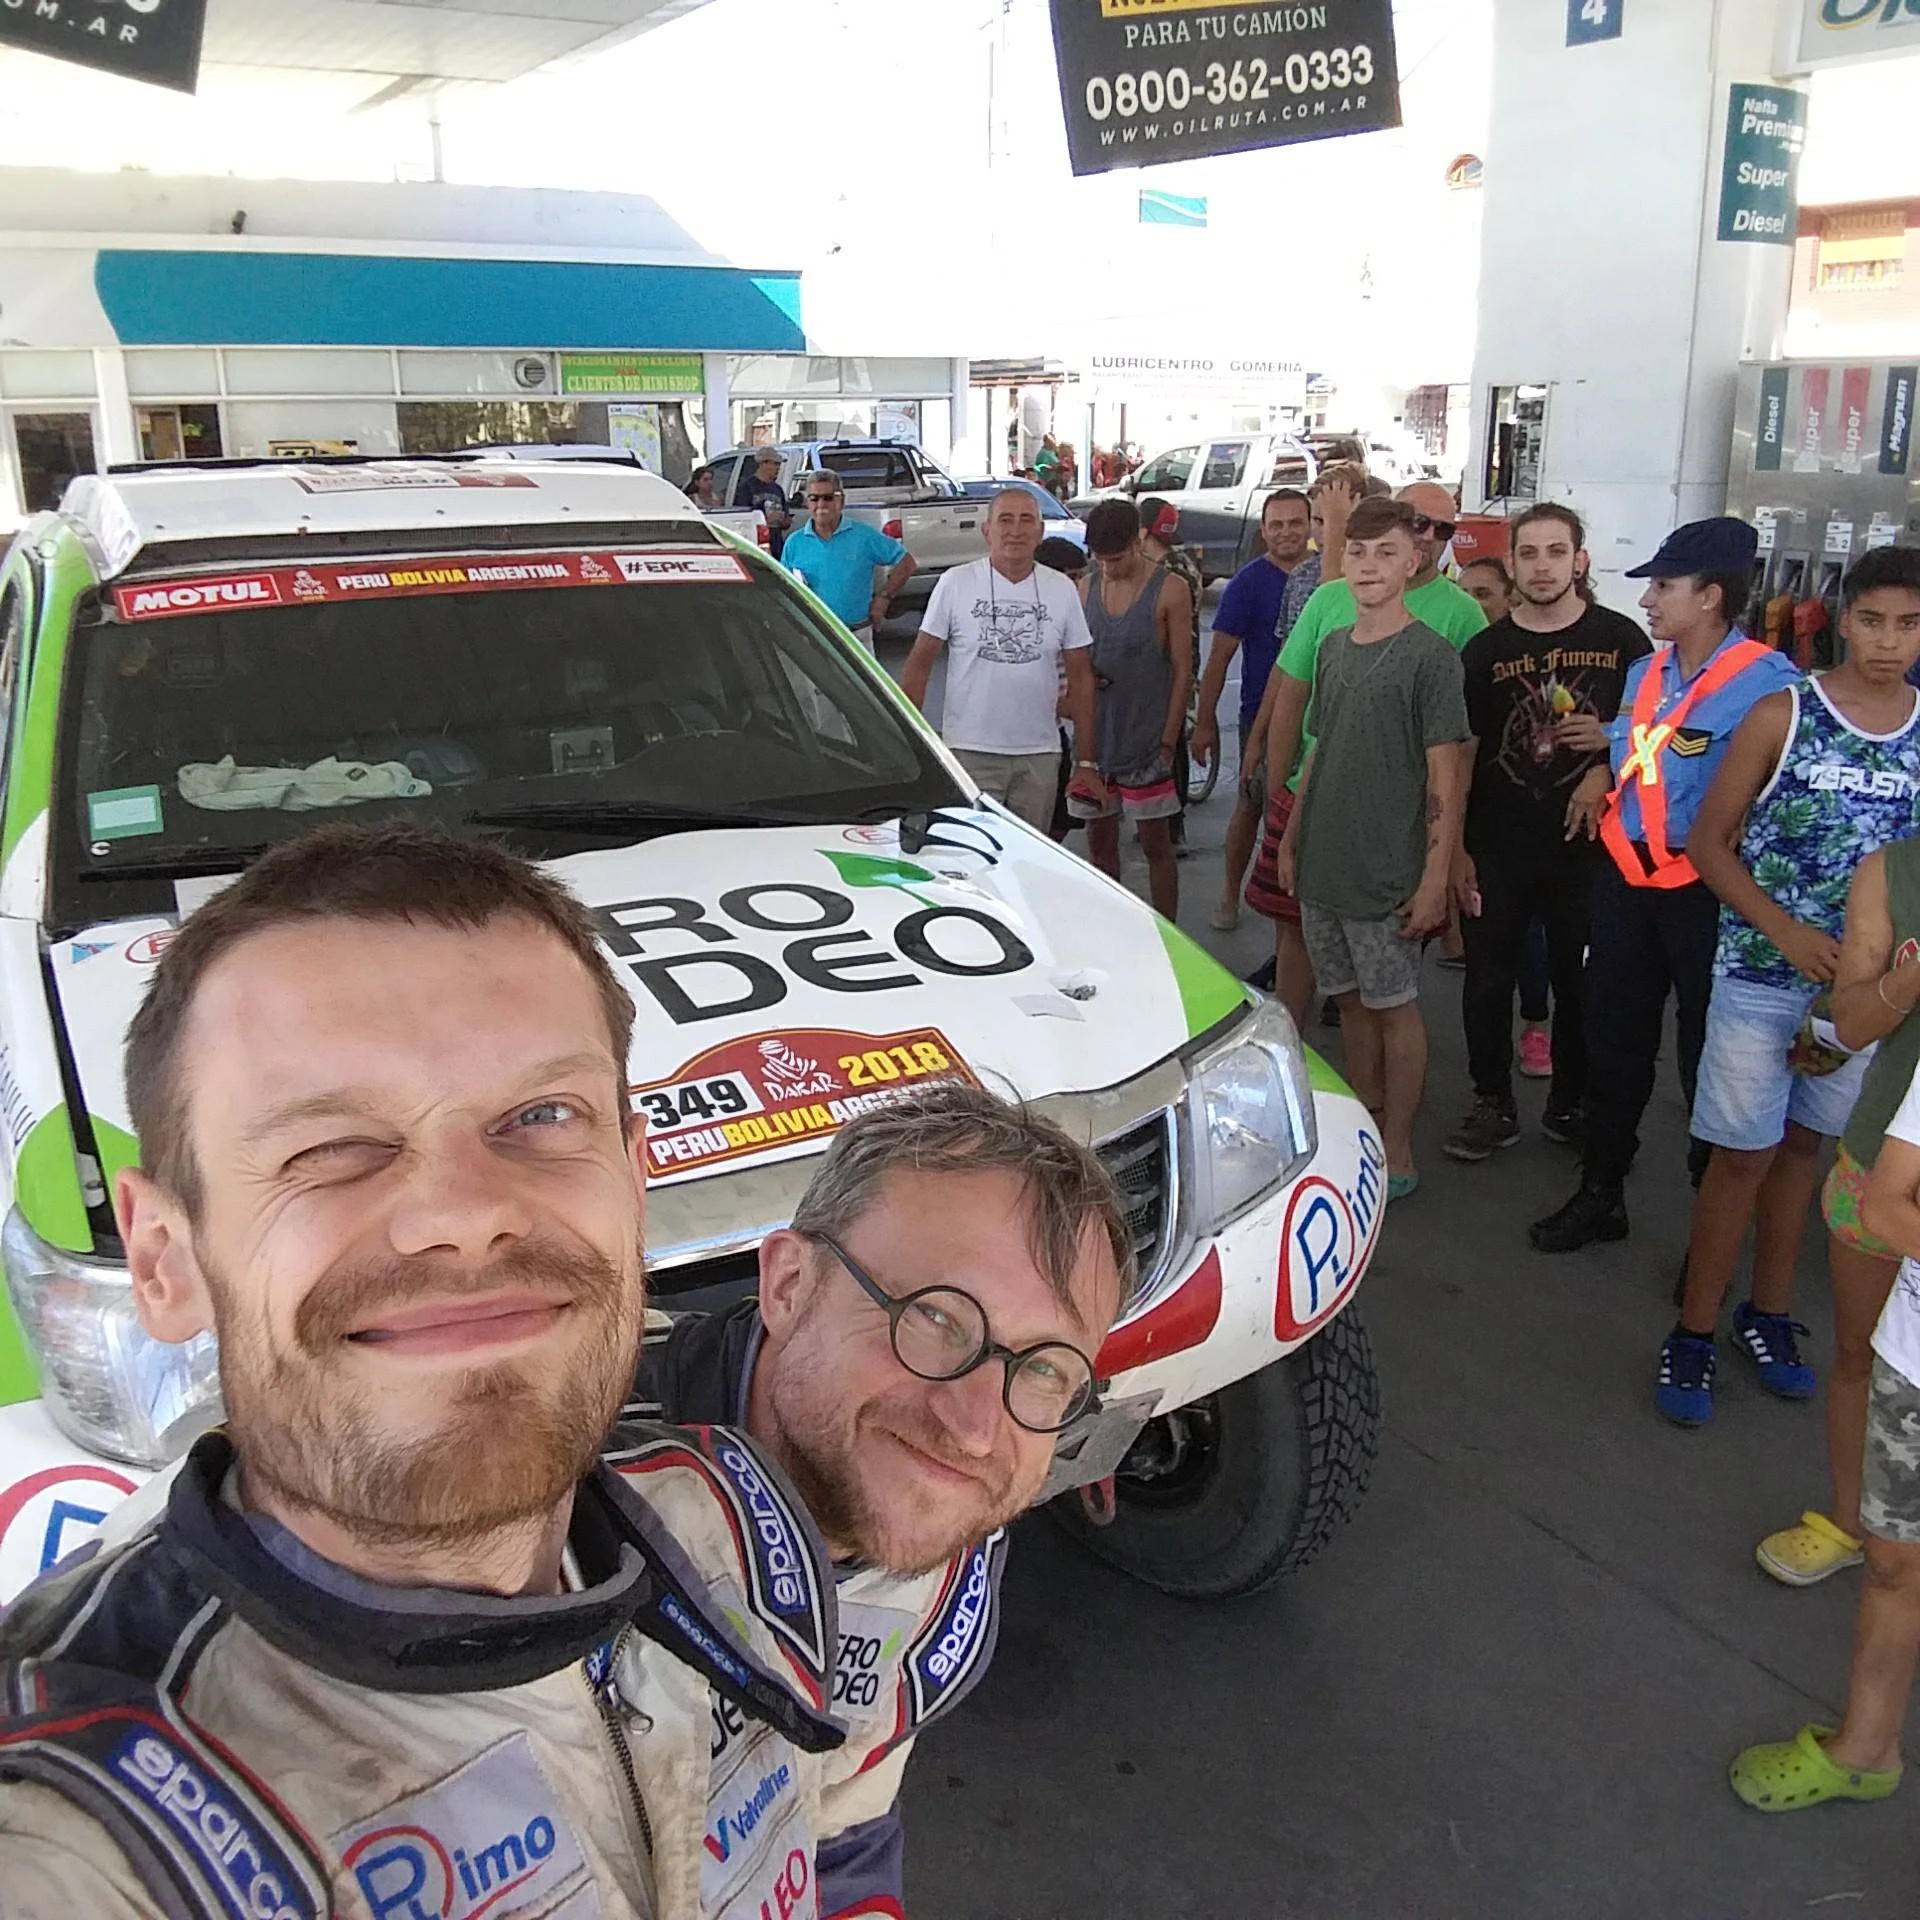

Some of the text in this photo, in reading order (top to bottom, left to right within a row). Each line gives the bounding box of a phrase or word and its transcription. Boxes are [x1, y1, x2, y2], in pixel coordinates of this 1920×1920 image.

[1125, 4, 1327, 48] PARA TU CAMIÓN
[1581, 0, 1607, 25] 4
[1086, 45, 1374, 121] 0800-362-0333
[1100, 95, 1369, 146] WWW.OILRUTA.COM.AR
[1743, 98, 1778, 115] Nafta
[1736, 162, 1789, 190] Super
[1732, 209, 1787, 234] Diesel
[567, 375, 624, 392] CLIENTES
[625, 376, 641, 391] DE
[1092, 356, 1302, 372] LUBRICENTRO GOMERIA
[1764, 395, 1780, 443] Diesel
[1889, 379, 1908, 453] Magnum
[132, 582, 270, 613] MOTUL
[336, 564, 570, 590] PERU BOLIVIA ARGENTINA
[1492, 647, 1619, 683] Dark Funeral
[628, 906, 1035, 1025] DEO
[837, 1041, 951, 1087] 2018
[640, 1079, 749, 1129] 349
[763, 1072, 843, 1102] DAKAR
[650, 1126, 729, 1166] PERU
[725, 1103, 836, 1149] BOLIVIA
[721, 1449, 807, 1607] sparco
[928, 1553, 987, 1685] sparco
[730, 1764, 791, 1840] Valvoline
